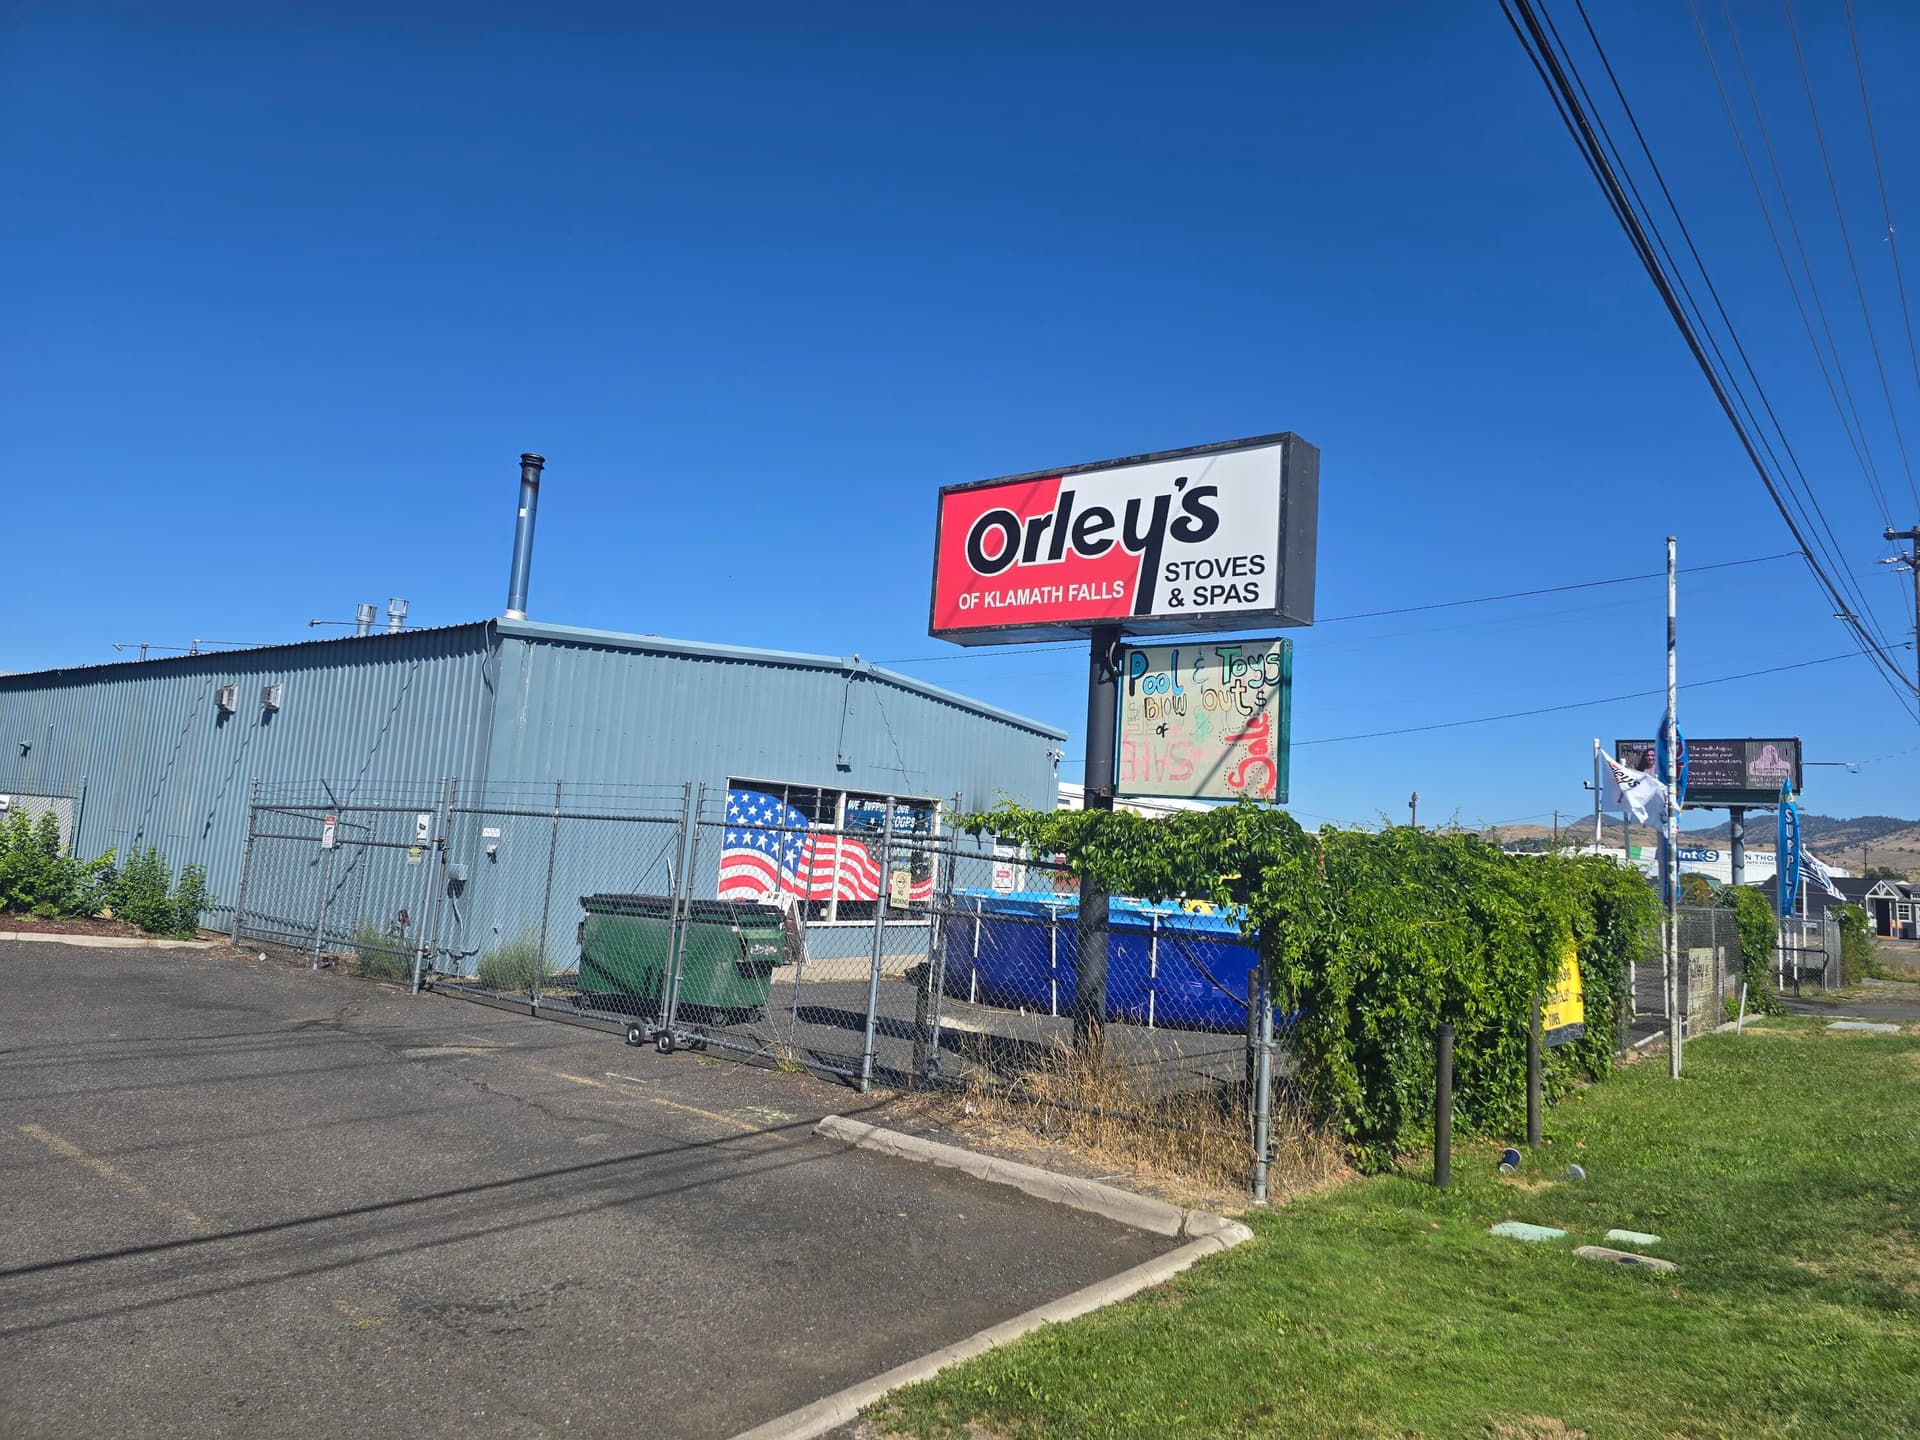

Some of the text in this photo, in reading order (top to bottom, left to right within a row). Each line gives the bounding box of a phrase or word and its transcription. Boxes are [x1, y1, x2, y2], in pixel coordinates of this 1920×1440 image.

[967, 477, 1220, 615] Orley's
[1164, 554, 1266, 582] STOVES
[958, 580, 1125, 610] OF KLAMATH FALLS
[1167, 582, 1260, 608] & SPAS
[1129, 649, 1184, 697] Pool
[1215, 646, 1281, 690] Toys
[1155, 722, 1169, 738] of
[1224, 712, 1277, 795] Sale
[847, 799, 861, 810] WE
